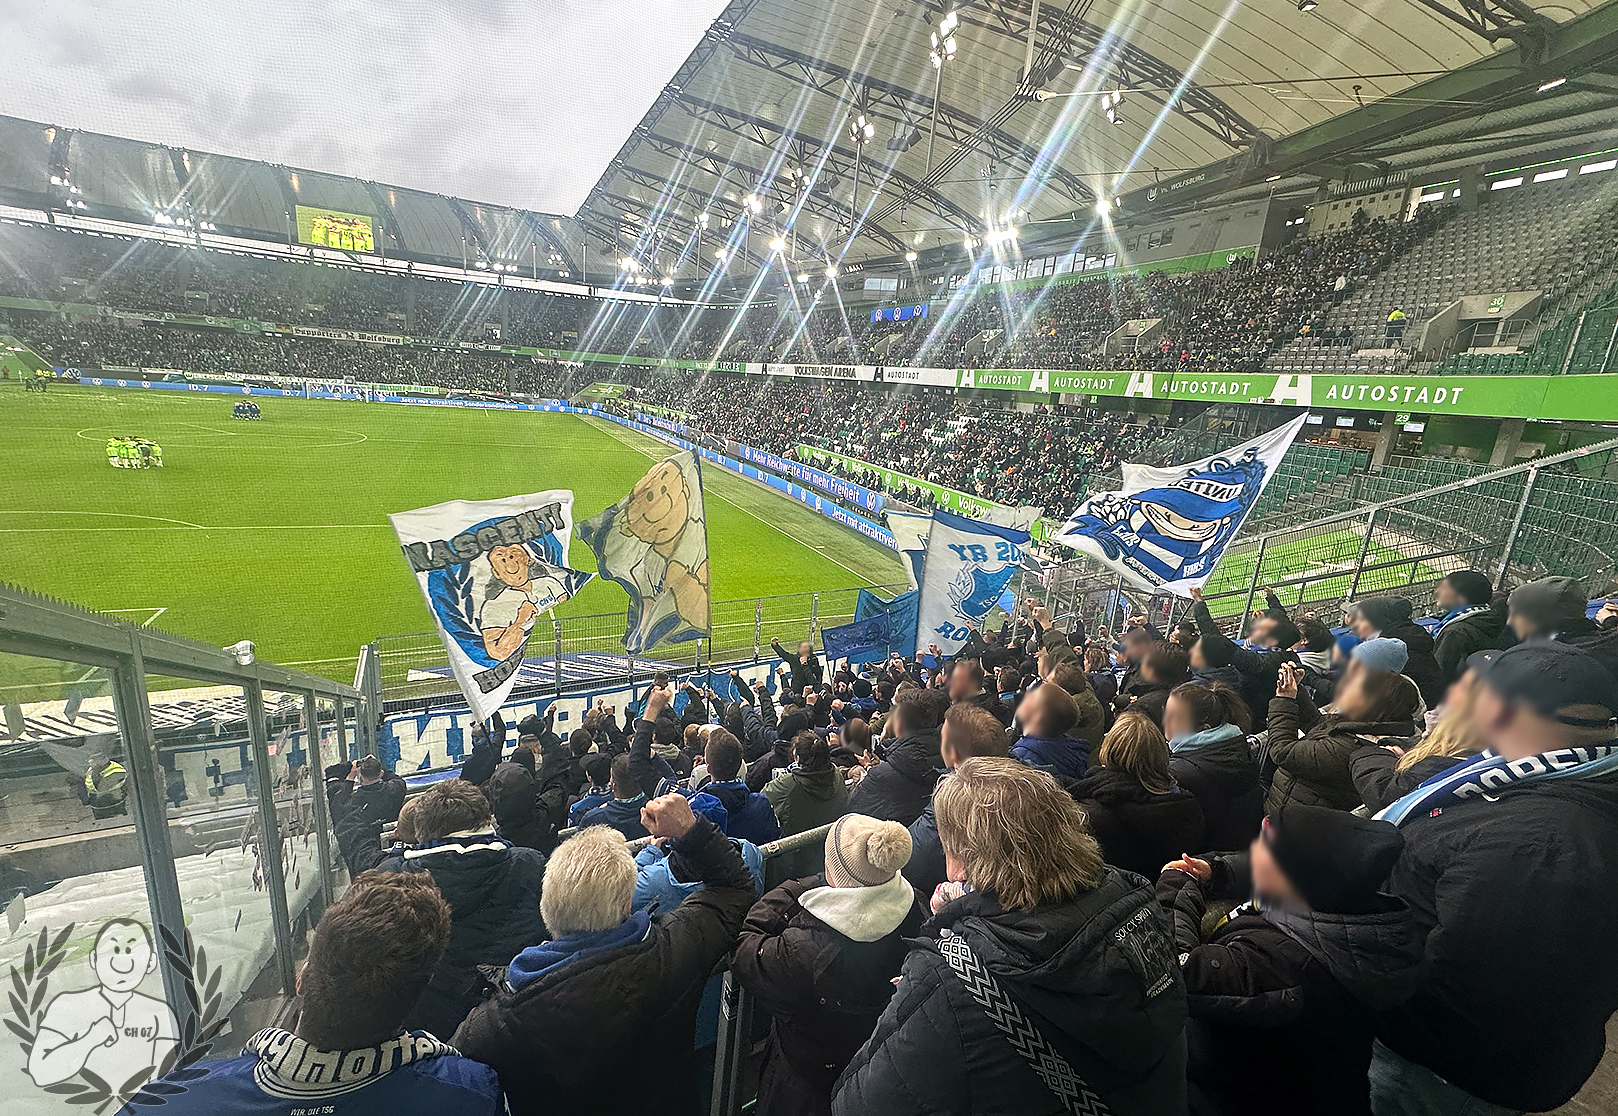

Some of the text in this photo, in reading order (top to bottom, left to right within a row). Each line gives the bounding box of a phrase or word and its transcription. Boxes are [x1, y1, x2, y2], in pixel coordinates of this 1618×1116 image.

[358, 332, 401, 344] Wolfsburg
[793, 364, 833, 378] VOLKSWAGEN
[833, 366, 857, 379] ARENA
[887, 370, 919, 380] AUTOSTADT
[977, 373, 1023, 386] AUTOSTADT
[1053, 376, 1115, 390] AUTOSTADT
[1160, 379, 1252, 396] AUTOSTADT
[1326, 384, 1464, 405] AUTOSTADT
[429, 399, 463, 407] attraktiven
[463, 401, 519, 409] Sonderkonditionen
[1396, 414, 1409, 423] 29
[752, 452, 767, 466] Mehr
[766, 455, 801, 478] Reichweite
[801, 467, 812, 481] für
[812, 471, 830, 489] mehr
[830, 477, 860, 503] Freiheit
[832, 507, 898, 549] Jetzt mit attraktiven
[947, 543, 989, 563] YB
[321, 1105, 335, 1114] TSG
